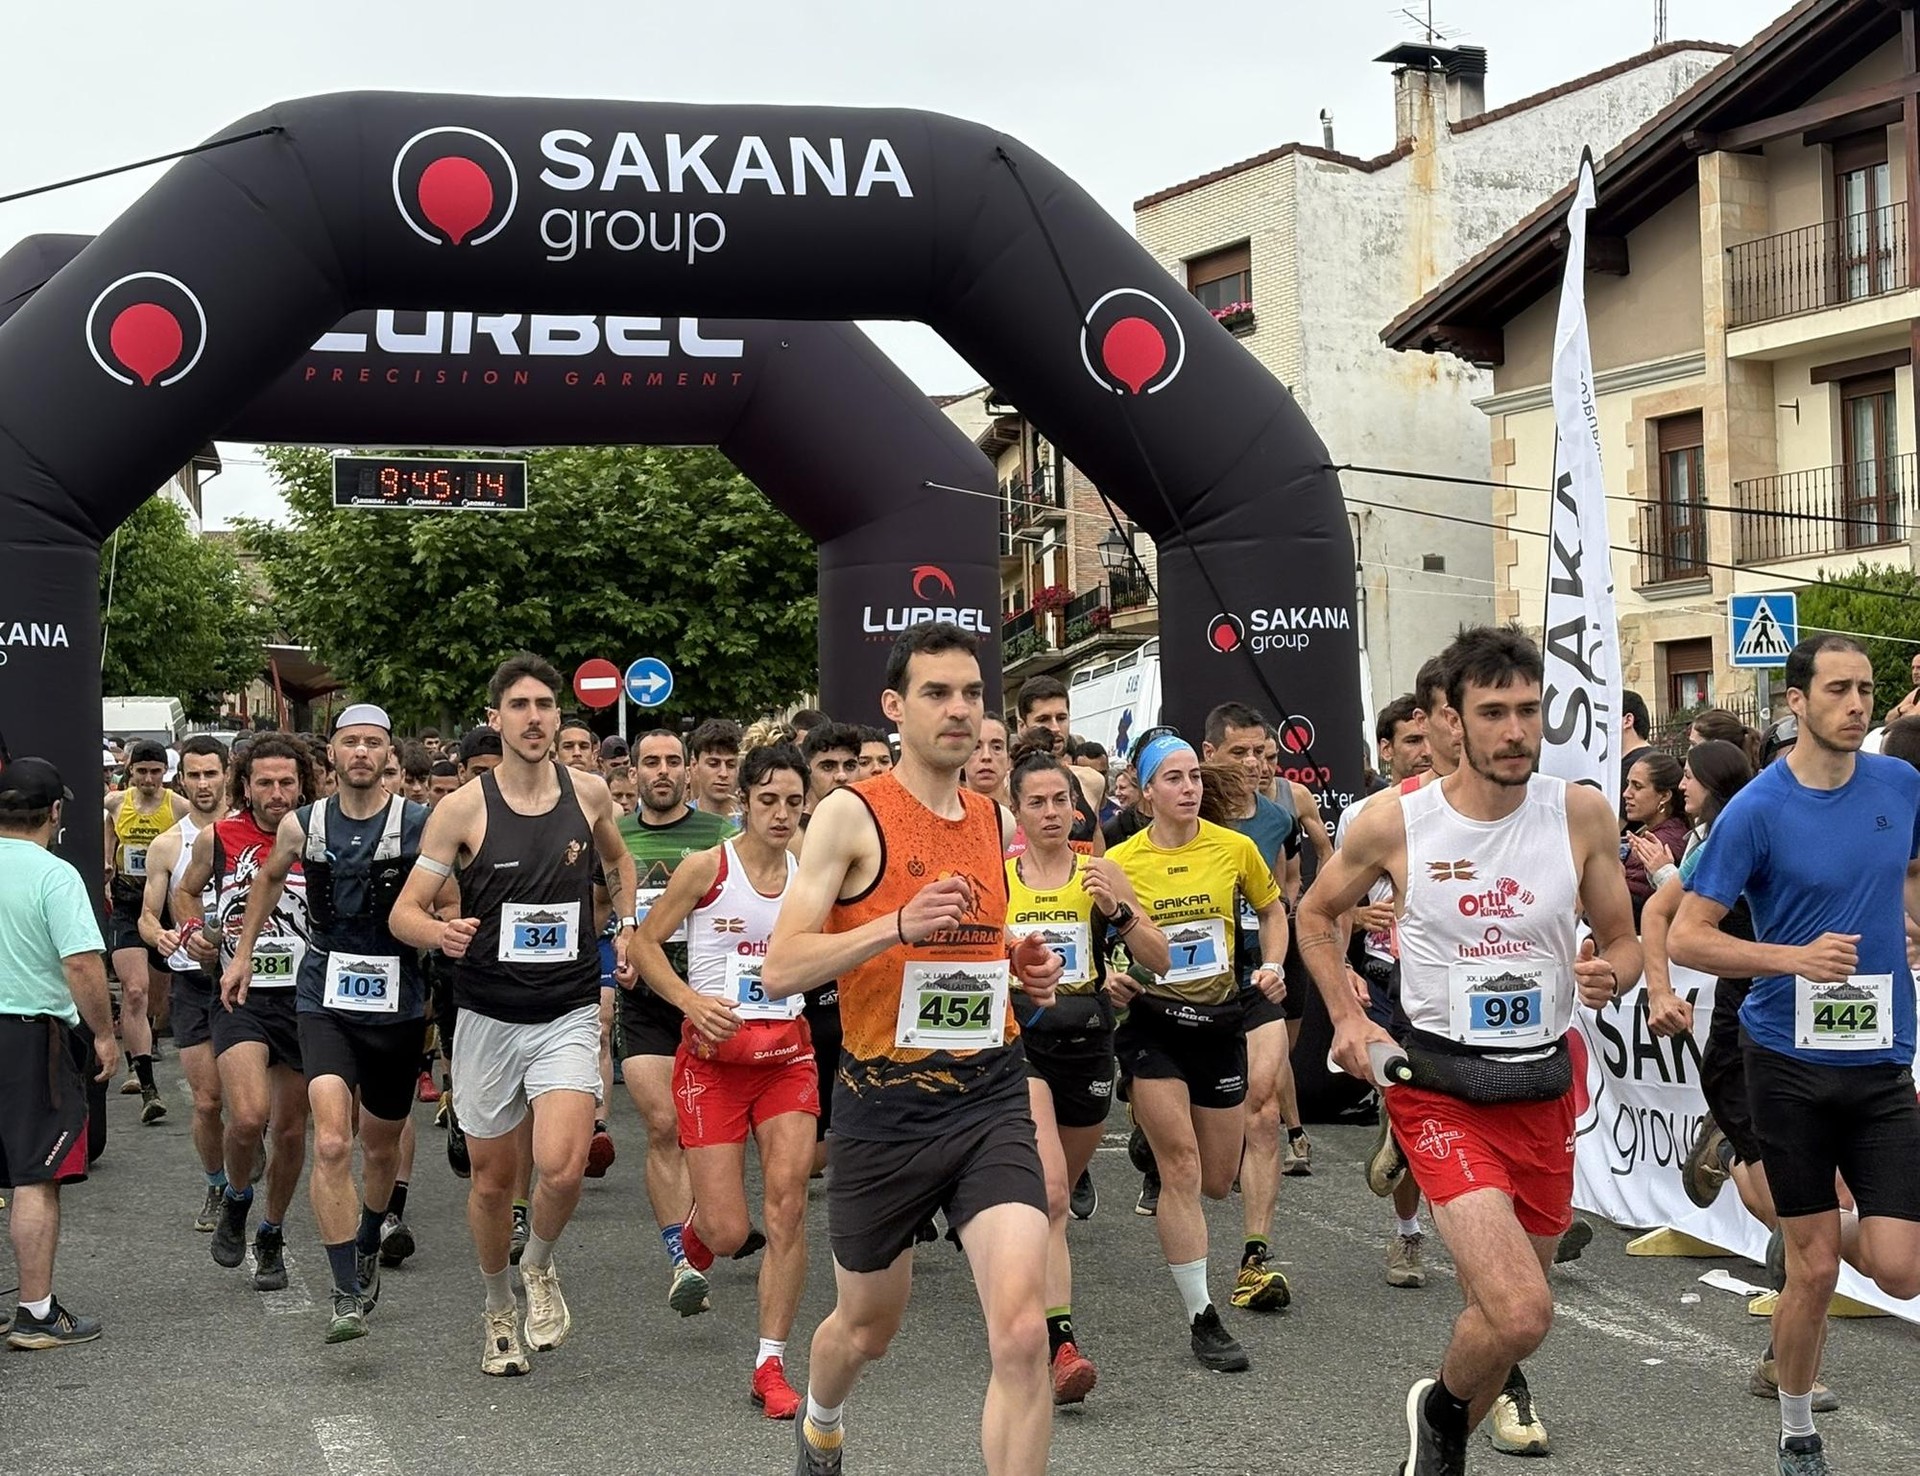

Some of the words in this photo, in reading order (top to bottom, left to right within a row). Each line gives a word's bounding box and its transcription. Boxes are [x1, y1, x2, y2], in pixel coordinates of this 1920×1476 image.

[540, 129, 914, 197] SAKANA
[540, 208, 726, 264] group
[305, 368, 529, 385] PRECISION
[565, 371, 742, 386] GARMENT
[380, 468, 504, 499] 9:45:14
[1250, 607, 1350, 631] SAKANA
[1250, 633, 1310, 654] group
[1153, 894, 1211, 911] GAIKAR
[1458, 889, 1508, 917] Ortu
[1015, 910, 1078, 923] GAIKAR
[524, 927, 558, 948] 34
[250, 956, 291, 974] 381
[1182, 944, 1198, 965] 7
[340, 976, 386, 997] 103
[919, 996, 991, 1027] 454
[1165, 1008, 1213, 1023] LURBEL
[1484, 996, 1530, 1027] 98
[1814, 1004, 1877, 1030] 442
